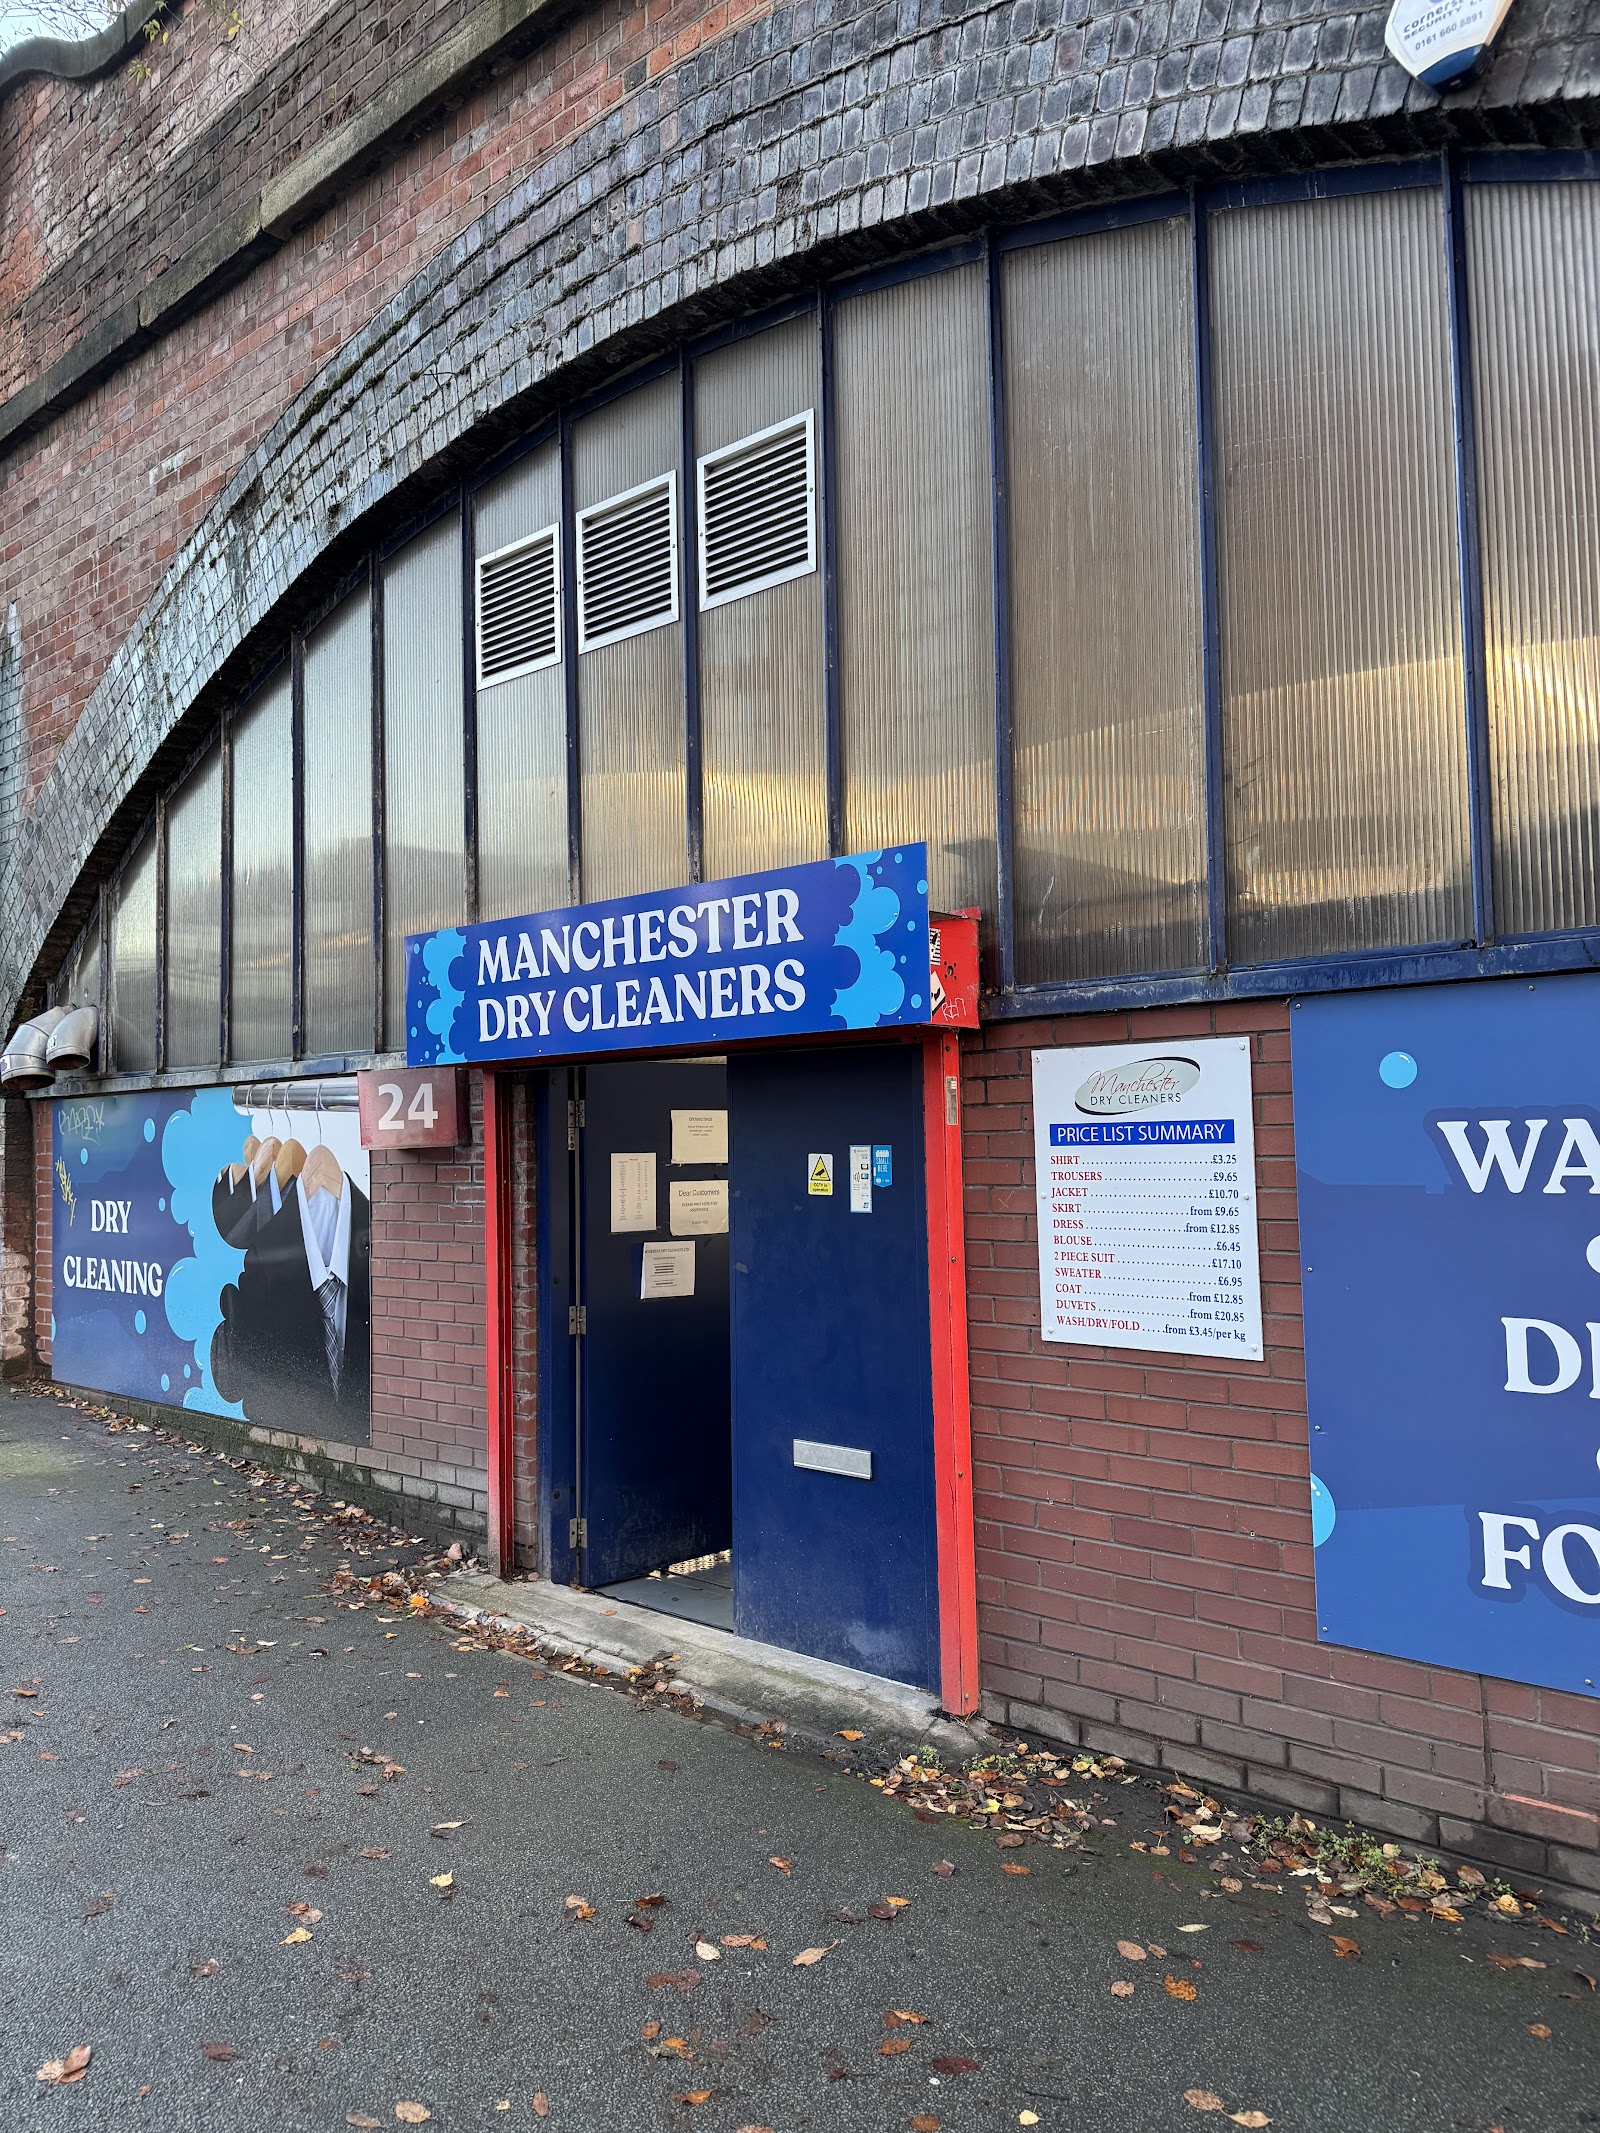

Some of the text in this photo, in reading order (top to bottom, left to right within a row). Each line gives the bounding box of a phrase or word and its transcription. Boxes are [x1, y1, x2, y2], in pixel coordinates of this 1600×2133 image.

[1403, 0, 1464, 33] corners
[1403, 6, 1462, 42] SECURITY
[1414, 10, 1484, 51] 0161 660 8891
[477, 888, 804, 986] MANCHESTER
[478, 959, 806, 1043] DRY CLEANERS
[1088, 1063, 1180, 1095] Manchester
[377, 1083, 438, 1130] 24
[1090, 1092, 1182, 1106] DRY CLEANERS
[1057, 1123, 1225, 1143] PRICE LIST SUMMARY
[1050, 1154, 1237, 1165] SHIRT £3.25
[1437, 1118, 1600, 1194] WA
[1051, 1171, 1238, 1182] TROUSERS £9.65
[678, 1189, 720, 1197] Dear Customers
[1051, 1187, 1239, 1200] JACKET £10.70
[90, 1199, 132, 1235] DRY
[1052, 1203, 1239, 1217] SKIRT from £9.65
[1053, 1219, 1240, 1234] DRESS from £12.85
[1053, 1235, 1241, 1252] BLOUSE £6.45
[1054, 1252, 1242, 1269] 2 PIECE SUIT £17.10
[63, 1255, 163, 1298] CLEANING
[1055, 1267, 1243, 1287] SWEATER £6.95
[1055, 1283, 1244, 1305] COAT from £12.85
[1056, 1299, 1245, 1322] DUVETS from £20.85
[1056, 1315, 1247, 1342] WASH/DRY/FOLD from £3.45/per kg
[1501, 1317, 1600, 1399] D
